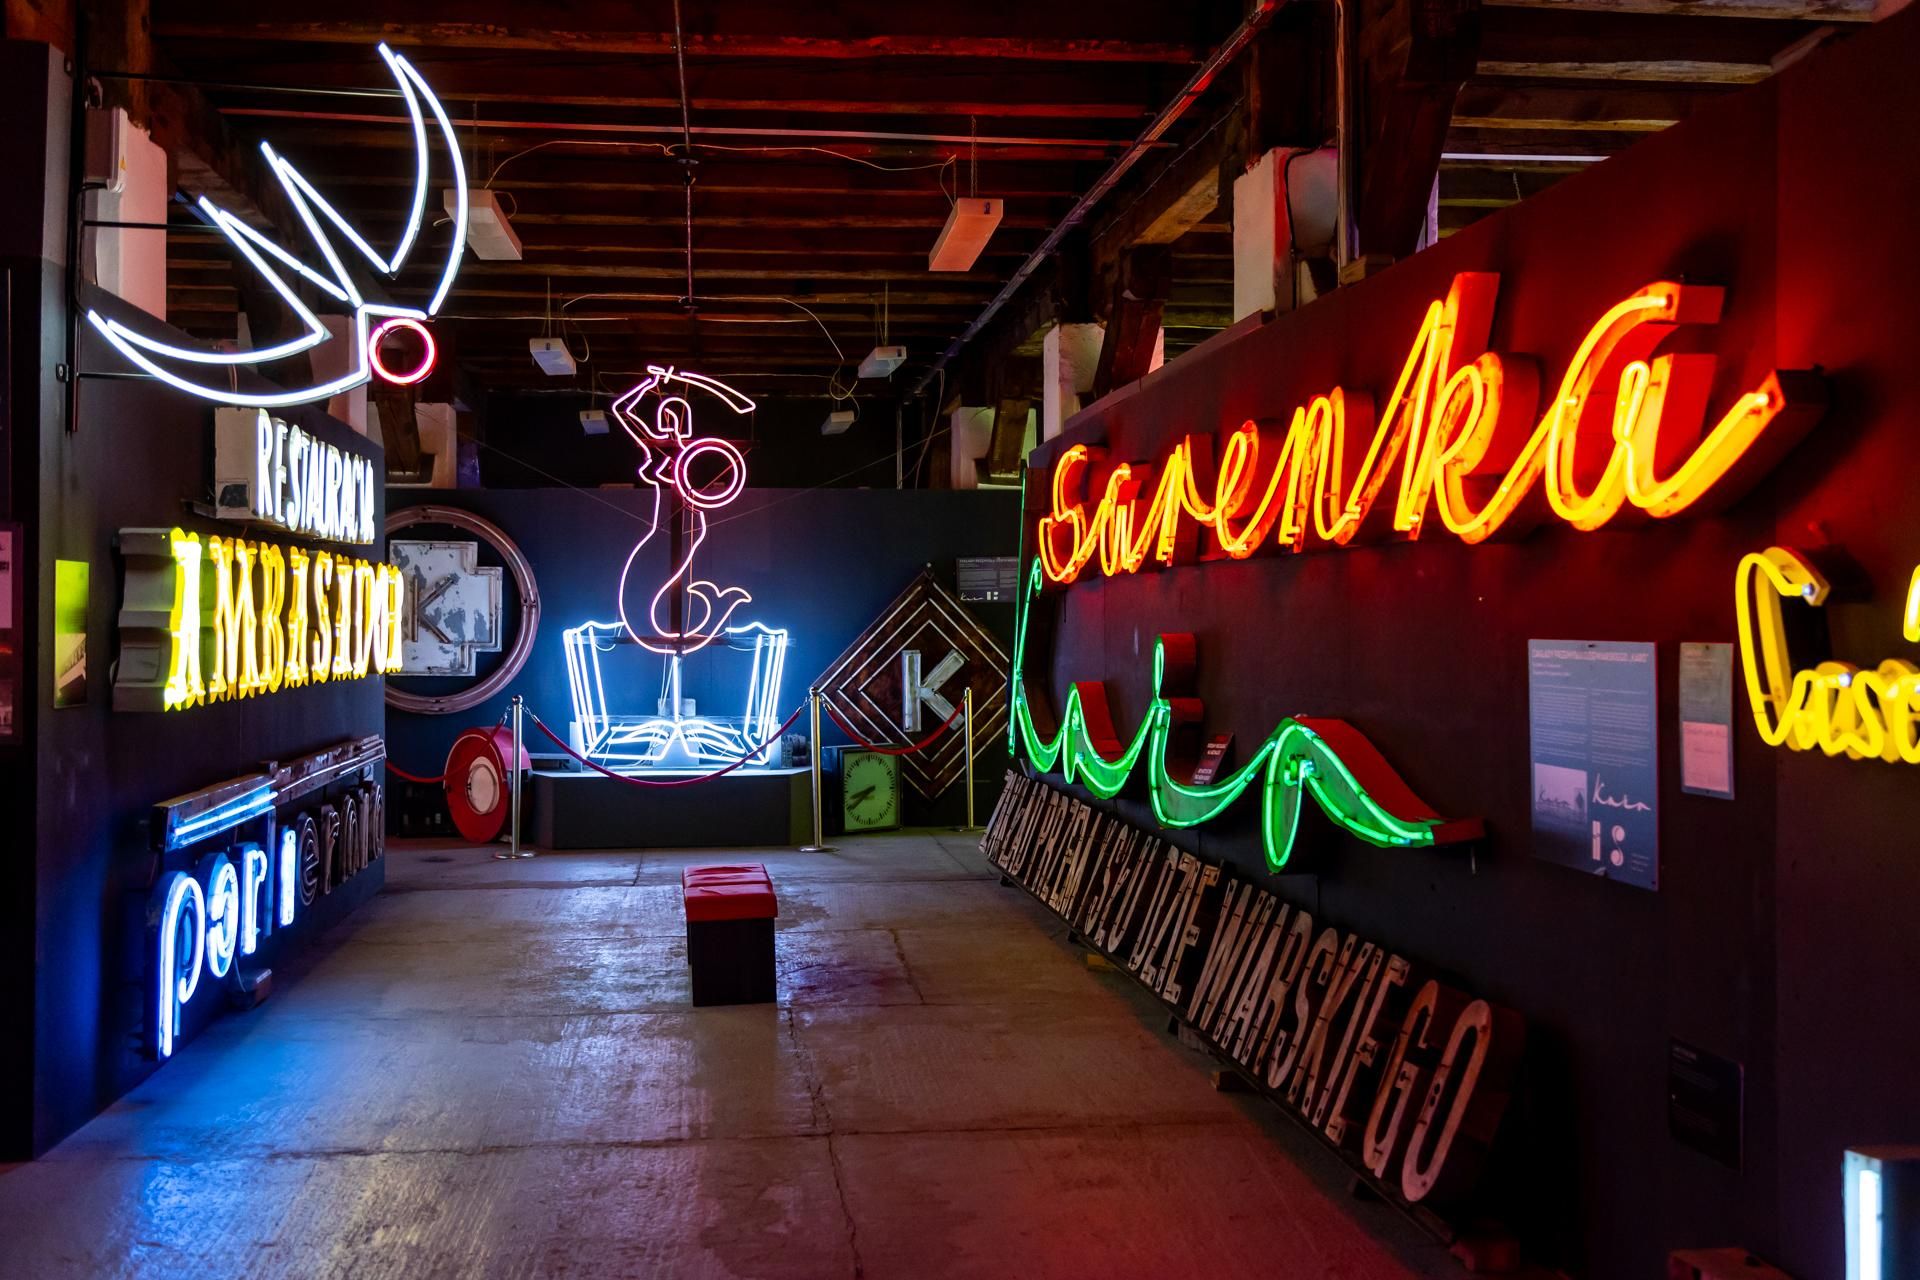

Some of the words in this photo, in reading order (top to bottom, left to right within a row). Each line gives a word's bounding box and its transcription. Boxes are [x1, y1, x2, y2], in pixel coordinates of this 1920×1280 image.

[256, 408, 375, 544] RESTAURACJA
[1039, 277, 1785, 583] Sarenka
[164, 527, 404, 711] AMBASADOR
[902, 649, 966, 733] K
